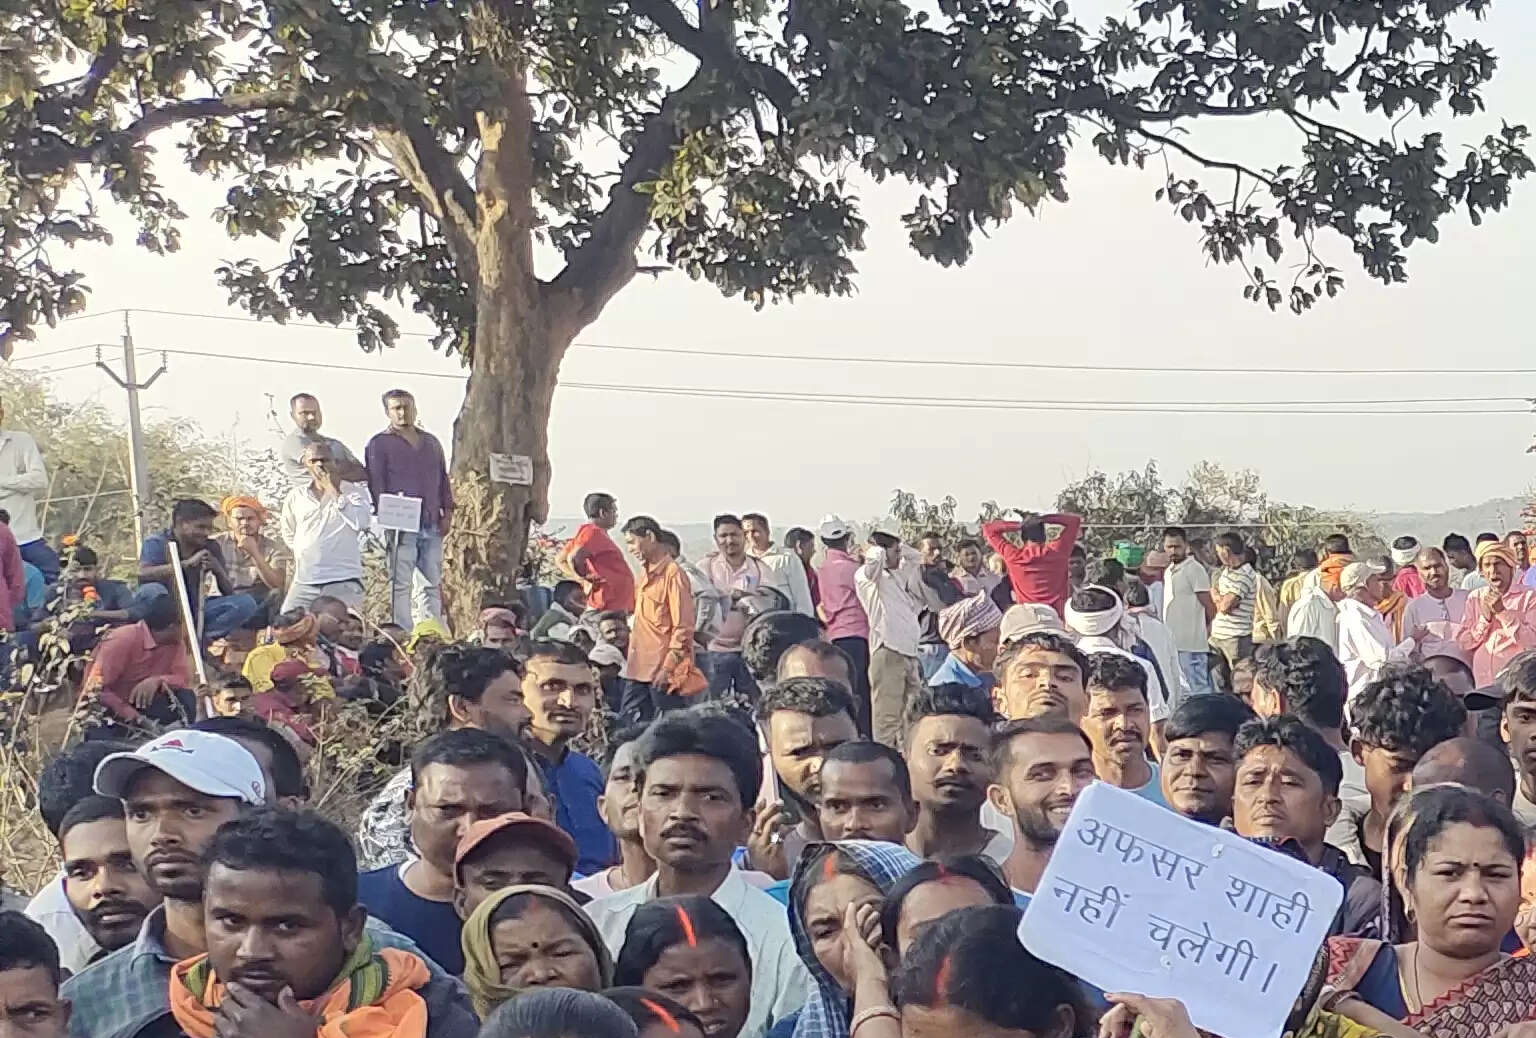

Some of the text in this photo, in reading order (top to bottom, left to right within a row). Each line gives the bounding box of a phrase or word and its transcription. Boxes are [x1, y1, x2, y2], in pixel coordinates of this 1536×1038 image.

[1053, 875, 1131, 930] नहीं
[1076, 817, 1315, 934] अफसर शाही
